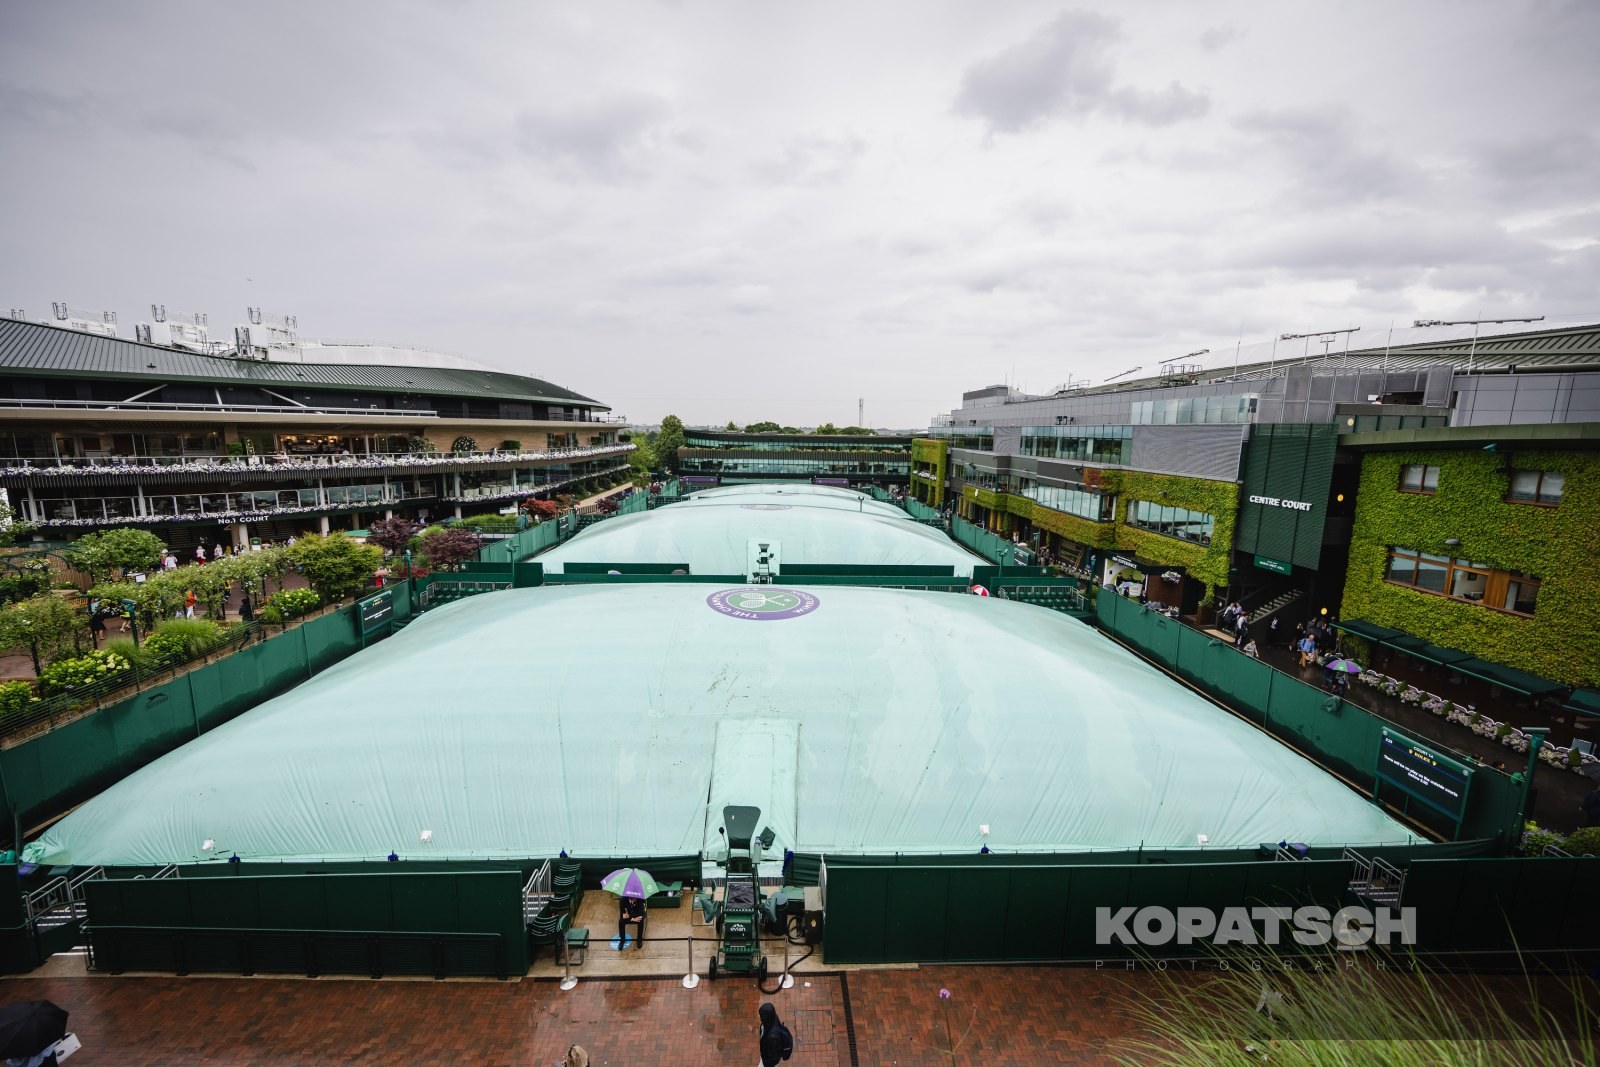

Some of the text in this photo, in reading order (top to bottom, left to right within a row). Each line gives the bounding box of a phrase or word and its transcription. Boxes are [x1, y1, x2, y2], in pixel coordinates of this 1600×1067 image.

[1249, 495, 1312, 511] CENTRE COURT
[1414, 746, 1428, 756] COURT
[1384, 754, 1394, 762] There
[1414, 752, 1431, 764] ROLEX
[1408, 772, 1420, 781] before
